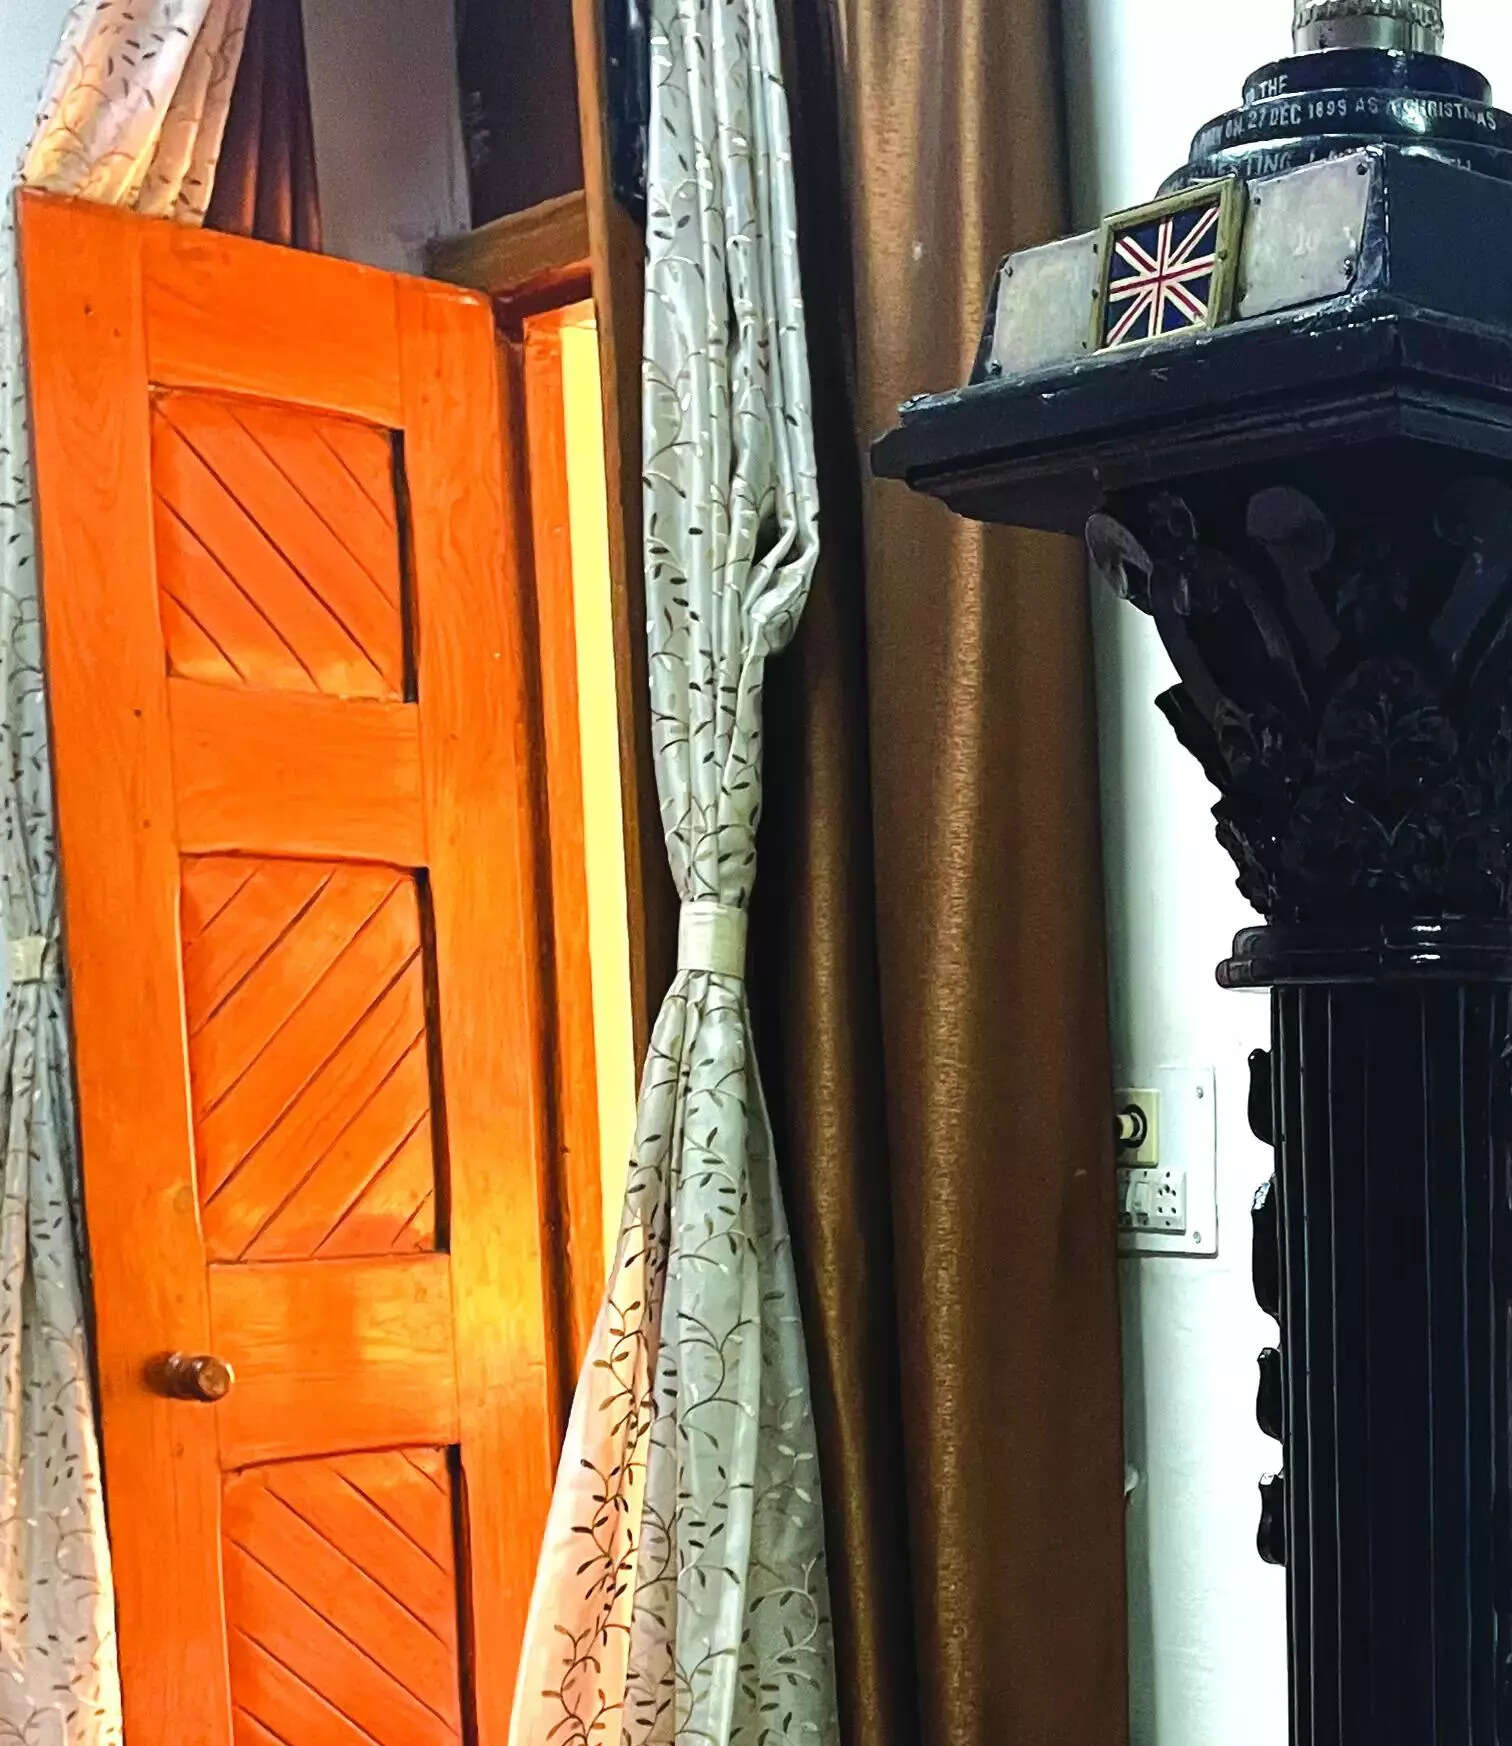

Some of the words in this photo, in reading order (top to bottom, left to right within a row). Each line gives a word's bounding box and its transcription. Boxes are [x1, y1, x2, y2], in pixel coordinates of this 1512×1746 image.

[1247, 109, 1266, 130] 27
[1270, 107, 1303, 127] DEC
[1355, 96, 1380, 114] AS
